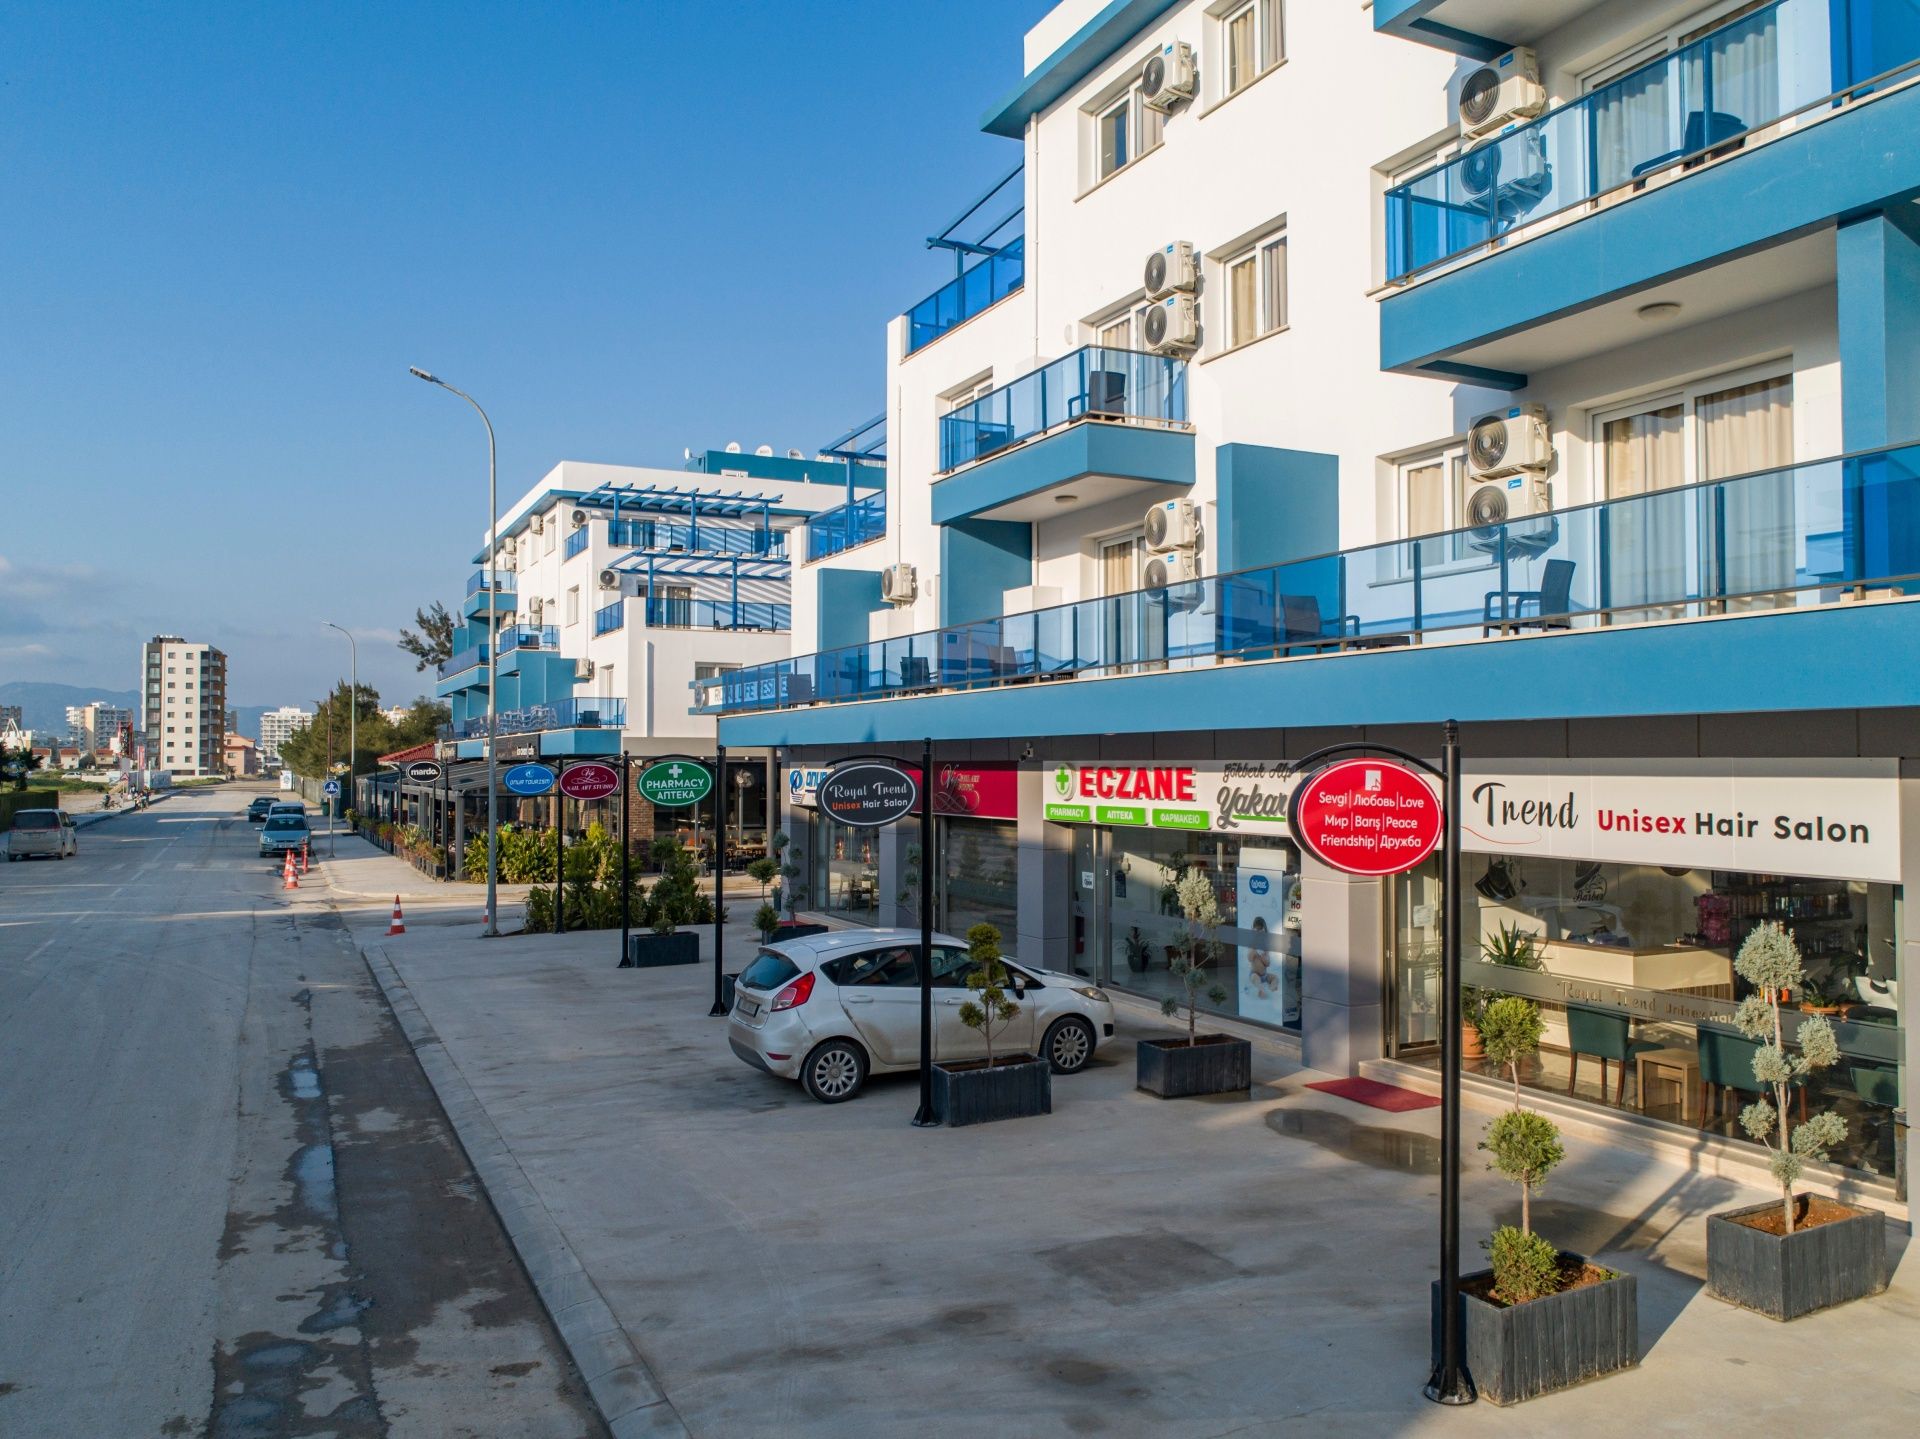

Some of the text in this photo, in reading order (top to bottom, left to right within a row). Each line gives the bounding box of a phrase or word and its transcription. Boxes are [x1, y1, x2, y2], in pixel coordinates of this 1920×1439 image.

[646, 778, 704, 789] PHARMACY
[1080, 766, 1197, 801] ECZANE
[657, 790, 696, 800] АПТЕКА
[829, 781, 908, 800] Royal Trend
[832, 798, 908, 810] Unisex Hair Salon
[1318, 791, 1348, 807] Sevgi
[1353, 794, 1396, 807] Любовь
[1400, 796, 1424, 808] Love
[1050, 807, 1085, 818] PHARMACY
[1107, 810, 1134, 821] АПТЕКА
[1472, 781, 1869, 844] Trend Unisex Hair Salon
[1324, 814, 1349, 828] Мир
[1386, 817, 1418, 829] Peace
[1320, 834, 1375, 850] Friendship
[1380, 835, 1422, 850] Дружба
[1290, 900, 1301, 910] Ho
[1709, 1010, 1734, 1025] Hai
